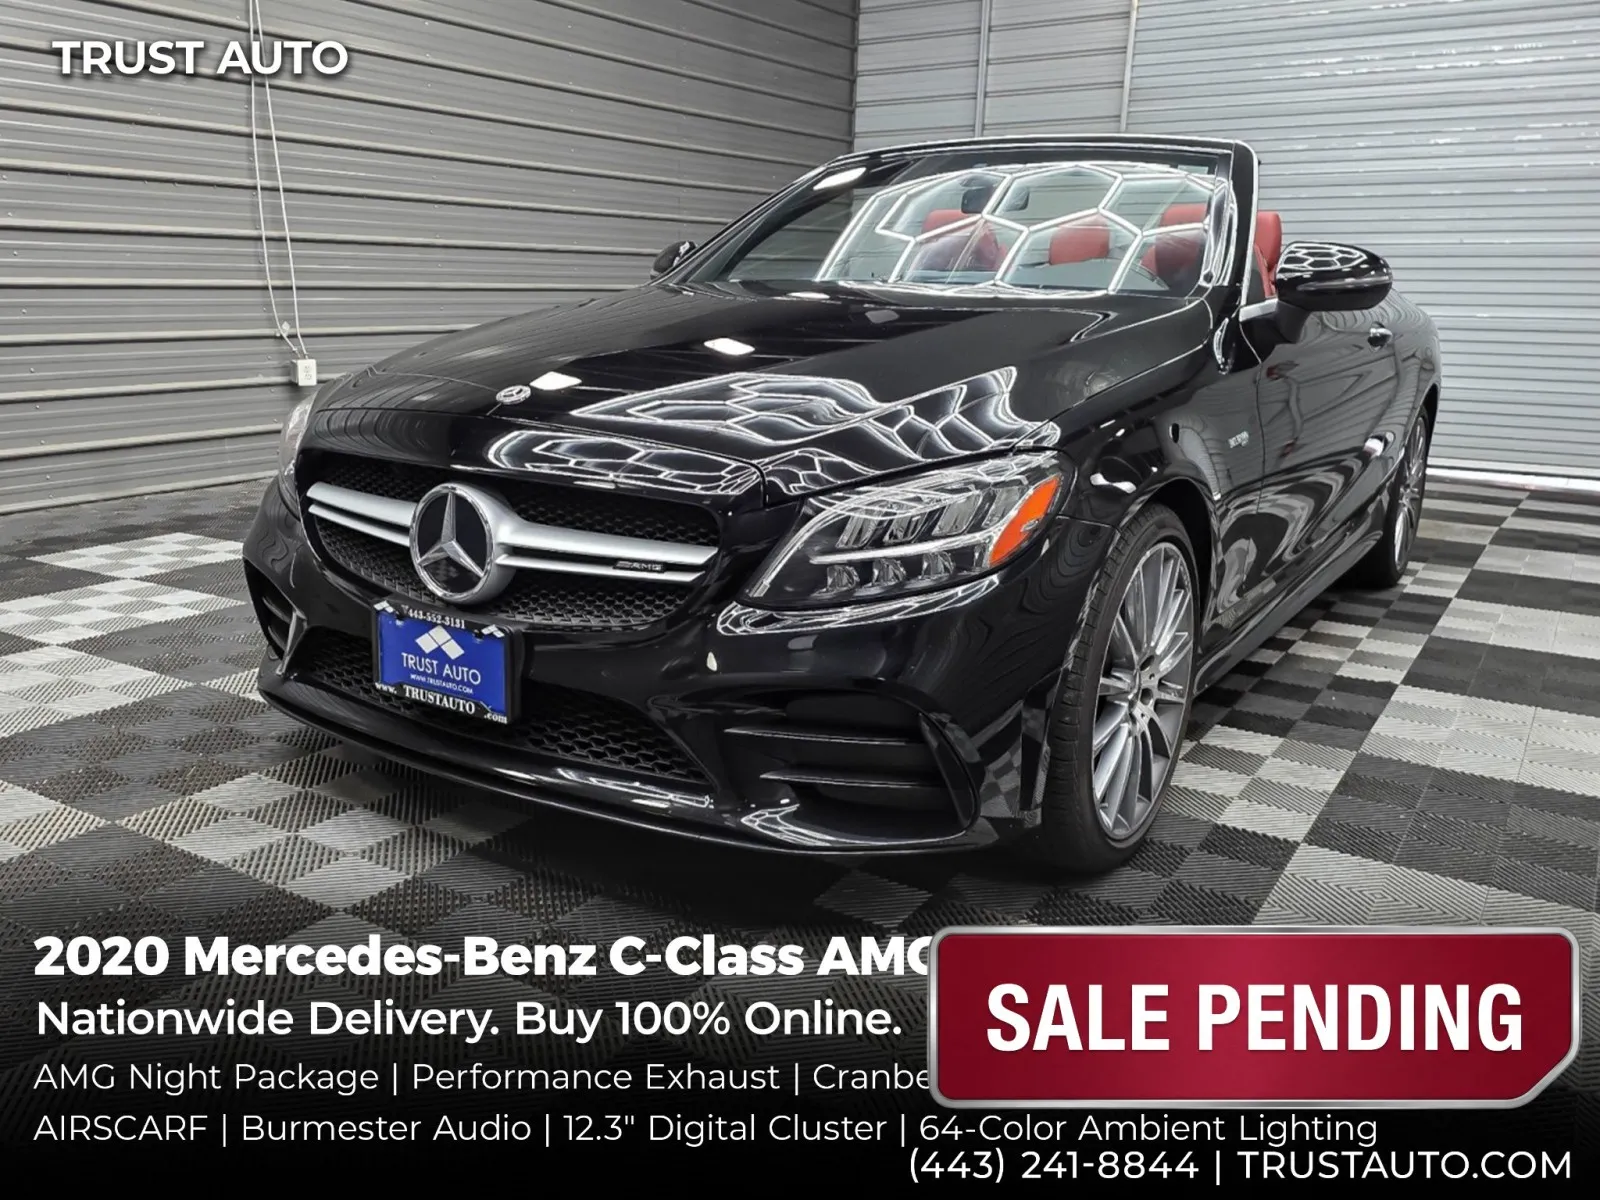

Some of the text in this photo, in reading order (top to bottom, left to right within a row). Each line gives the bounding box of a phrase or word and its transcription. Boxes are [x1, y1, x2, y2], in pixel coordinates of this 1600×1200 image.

[401, 652, 481, 685] TRUST AUTO
[410, 673, 474, 695] WWW.TRUSTAUTO.COM
[375, 681, 507, 725] www. TRUSTAUTO .com
